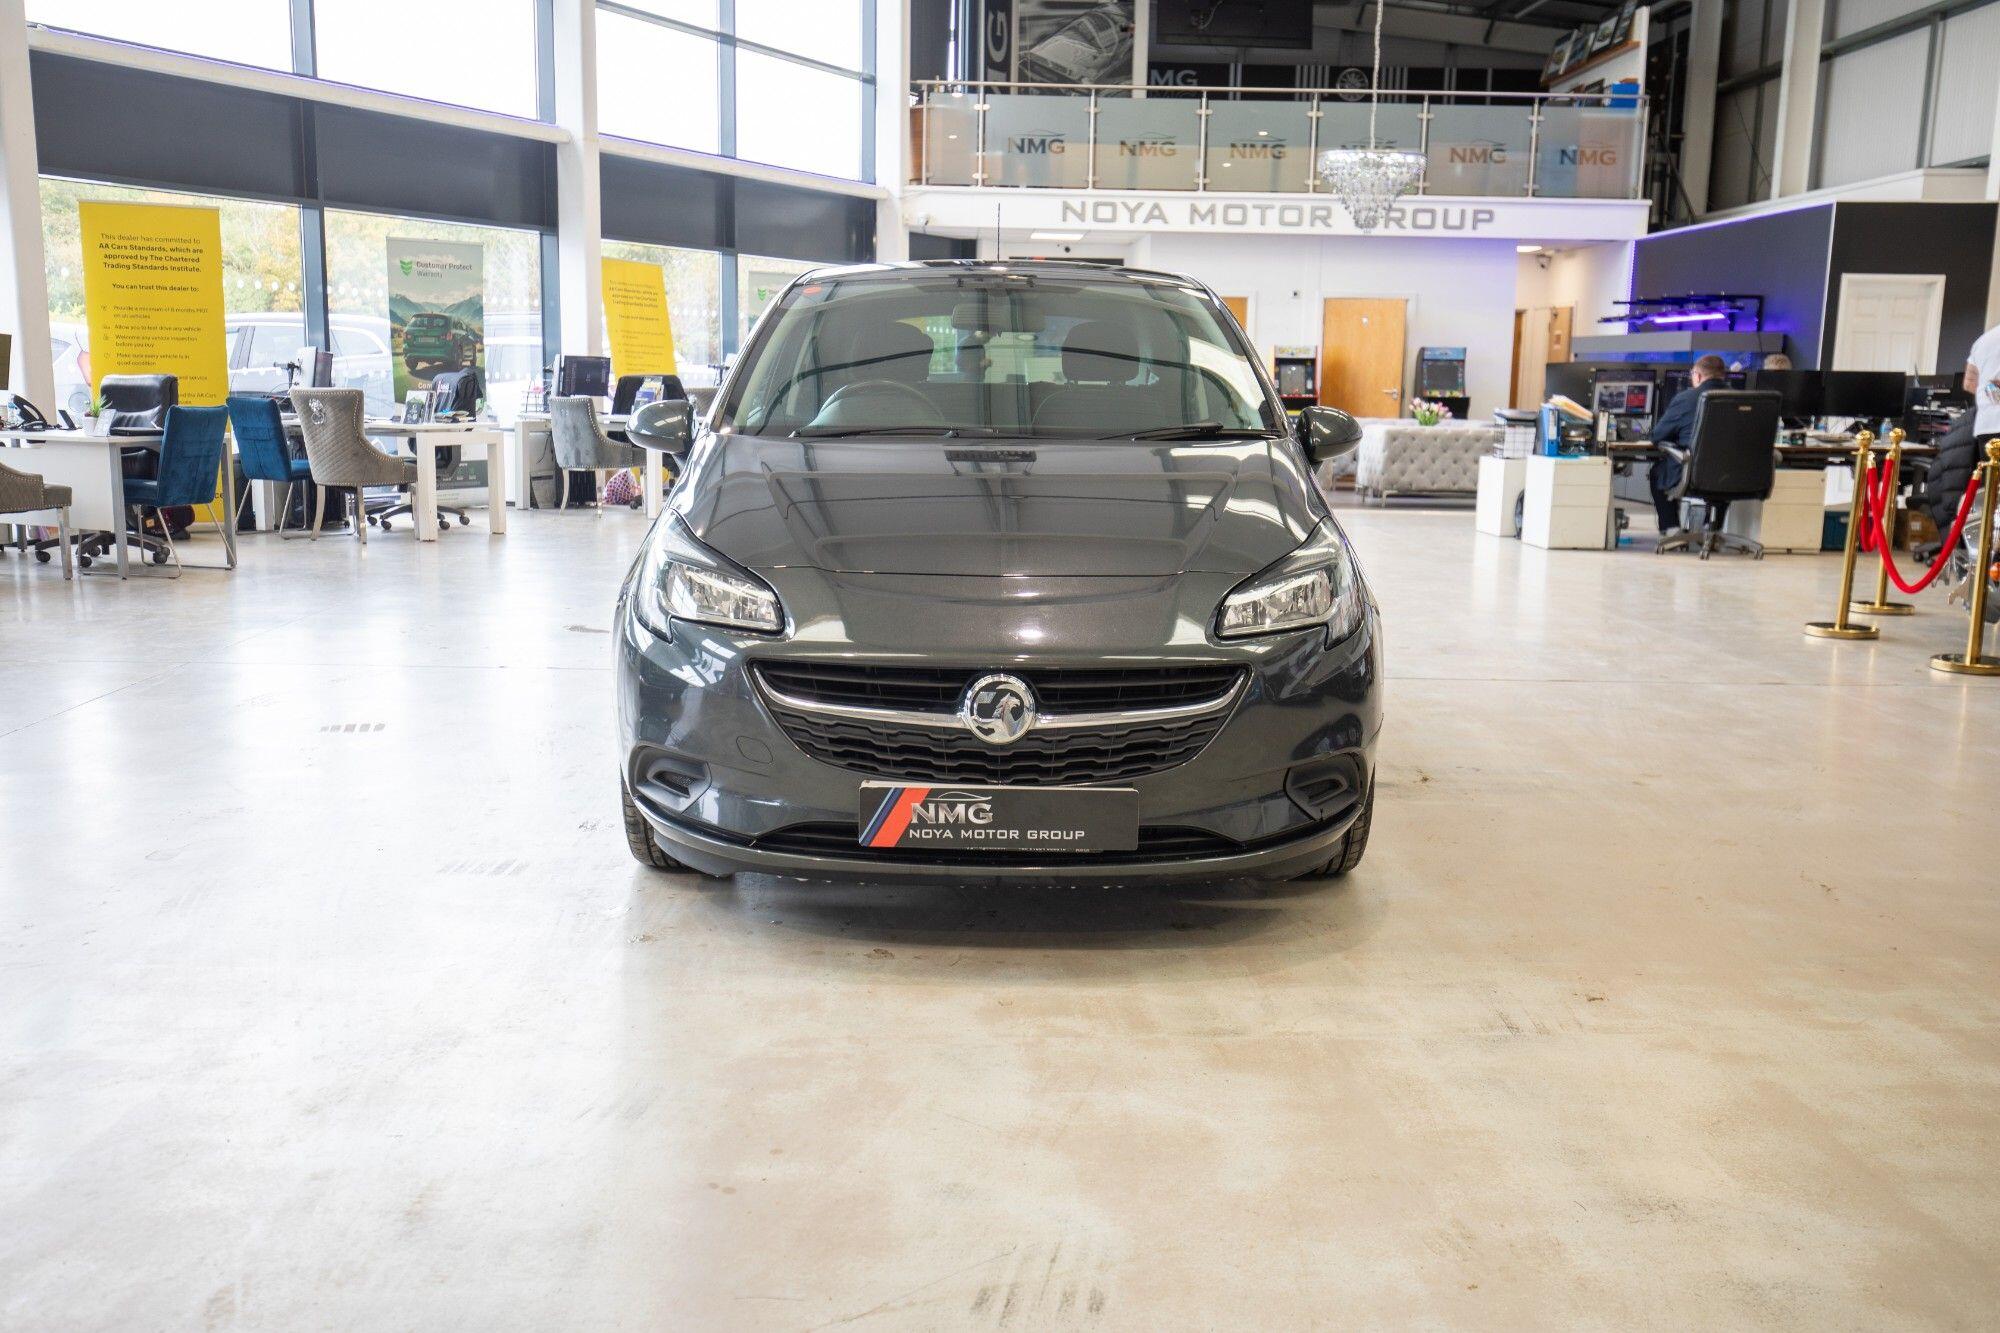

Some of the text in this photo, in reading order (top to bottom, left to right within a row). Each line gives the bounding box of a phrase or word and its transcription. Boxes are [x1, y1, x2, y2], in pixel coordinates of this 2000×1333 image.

[1008, 137, 1066, 154] NMG
[1119, 140, 1177, 157] NMG
[1229, 142, 1287, 160] NMG
[1449, 147, 1507, 165] NMG
[1560, 148, 1617, 166] NMG
[1061, 200, 1169, 225] NOYA
[1189, 202, 1332, 228] MOTOR
[118, 233, 139, 242] dealer
[155, 235, 192, 244] committed
[103, 262, 131, 270] Trading
[132, 263, 169, 271] Standards
[104, 253, 200, 263] approved by The Chartered
[449, 263, 473, 271] Protect
[911, 803, 993, 824] NMG
[909, 829, 1085, 841] NOYA MOTOR GROUP
